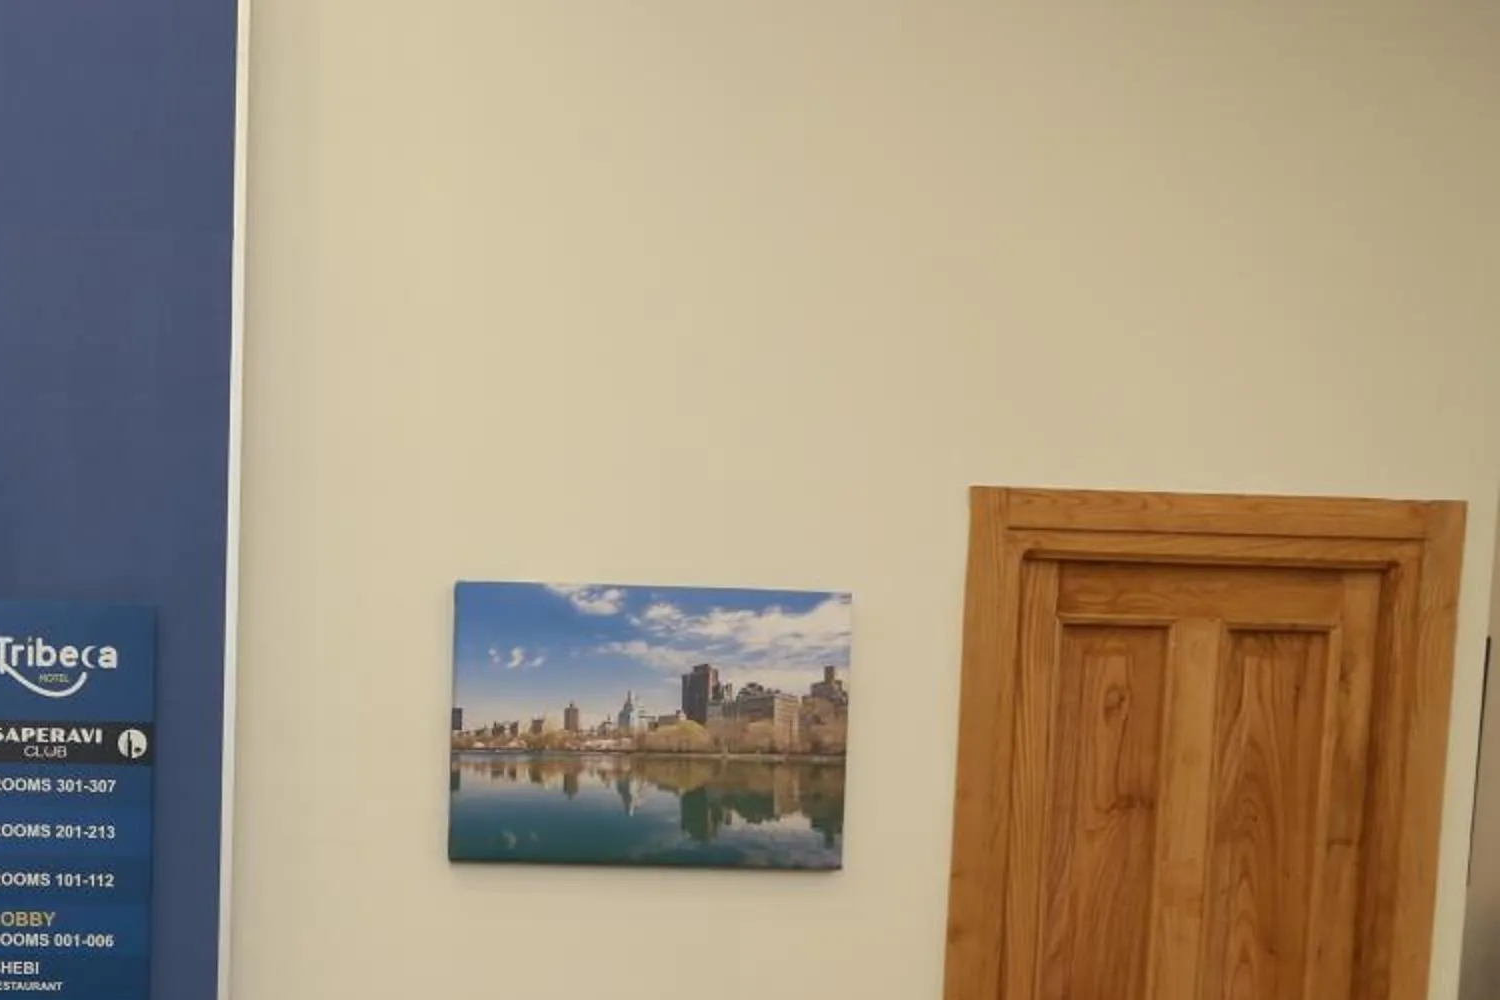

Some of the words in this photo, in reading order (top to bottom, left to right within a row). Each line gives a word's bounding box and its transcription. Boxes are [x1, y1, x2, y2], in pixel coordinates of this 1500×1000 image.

[39, 673, 69, 683] HOTEL
[23, 745, 67, 758] CLUB
[56, 779, 116, 793] 301-307
[55, 825, 116, 839] 201-213
[55, 873, 115, 888] 101-112
[53, 934, 115, 948] 001-006
